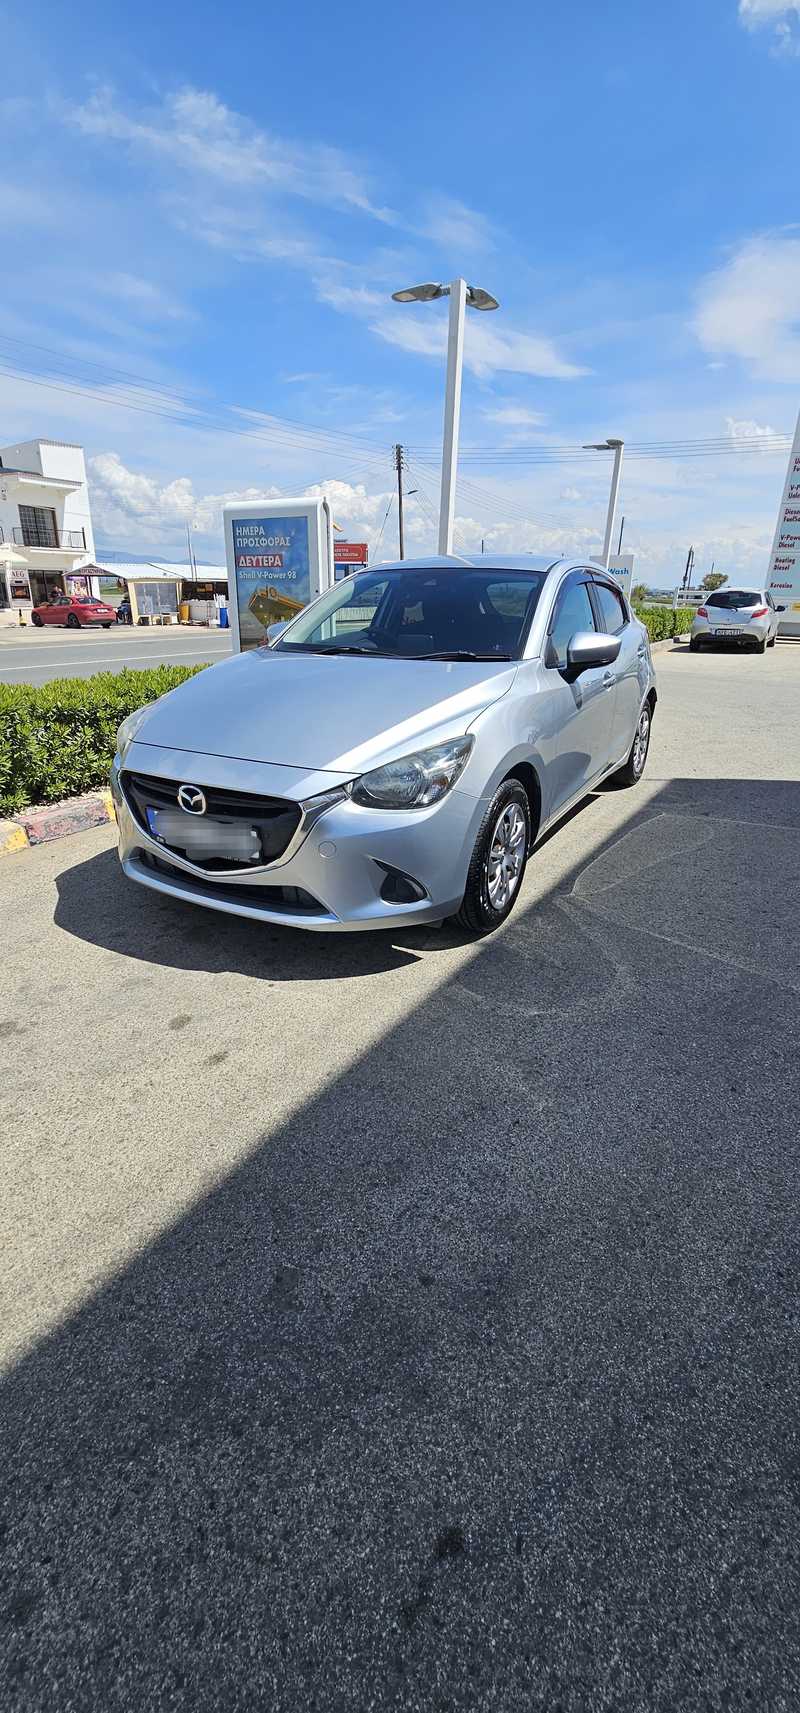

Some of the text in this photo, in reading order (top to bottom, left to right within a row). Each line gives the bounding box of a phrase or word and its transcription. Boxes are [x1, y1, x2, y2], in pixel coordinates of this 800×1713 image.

[236, 526, 265, 536] ΗΜΕΡΑ
[237, 537, 290, 547] ΠΡΟΣΦΟΡΑΣ
[239, 555, 282, 567] ΔΕΥΤΕΡΑ
[239, 570, 297, 579] Shell V-Power 98
